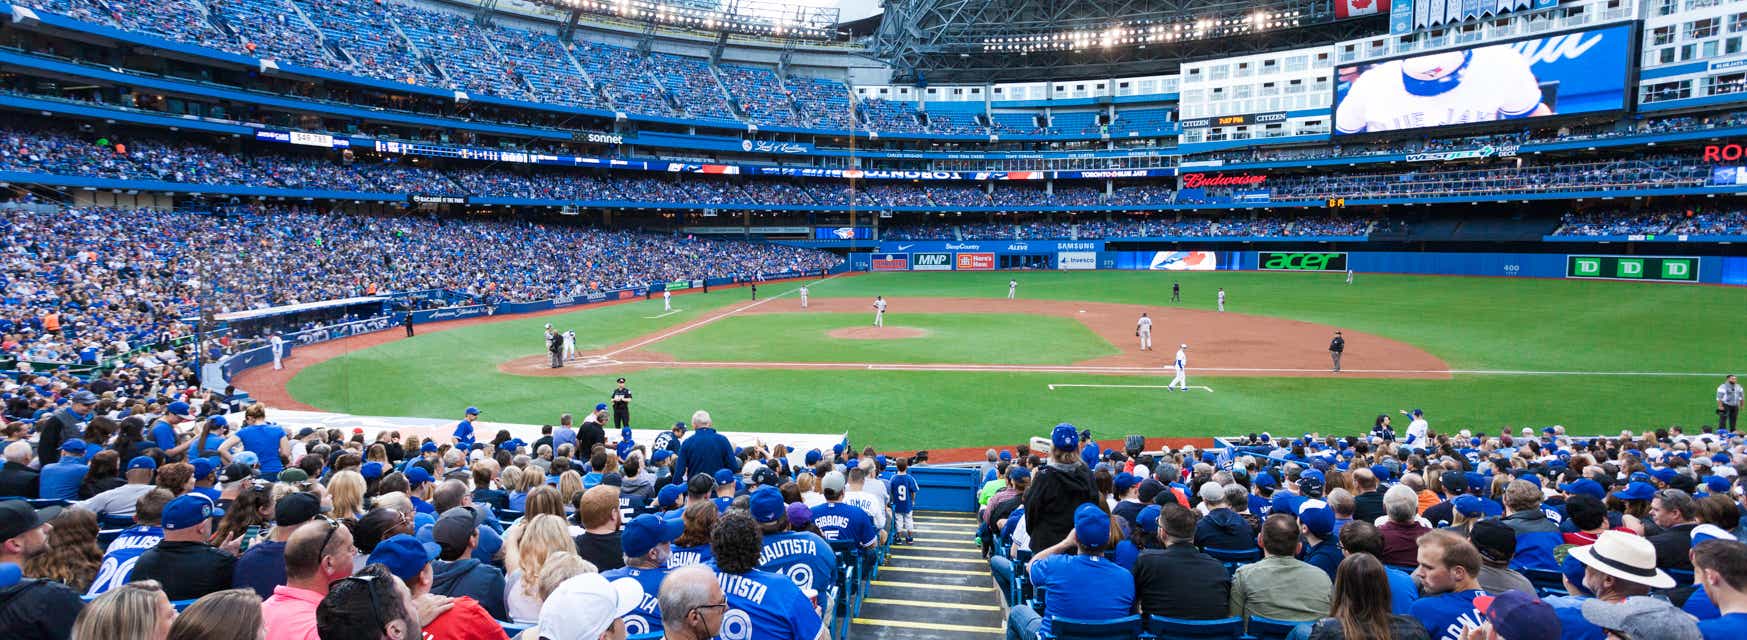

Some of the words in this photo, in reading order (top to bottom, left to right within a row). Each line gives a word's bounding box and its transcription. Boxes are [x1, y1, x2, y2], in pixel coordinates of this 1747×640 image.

[1182, 119, 1209, 128] CITIZEN
[1256, 112, 1286, 122] CITIZEN
[588, 133, 623, 144] sonnet
[1703, 144, 1747, 162] RO
[1081, 170, 1110, 178] TORONTO
[1183, 172, 1267, 188] Budweiser
[1057, 242, 1095, 250] SAMSUNG
[918, 254, 947, 265] MNP
[1265, 253, 1340, 270] acer
[1578, 260, 1598, 273] TD
[1620, 261, 1641, 274] TD
[1666, 262, 1688, 276] TD
[898, 485, 907, 501] 9
[815, 515, 849, 529] GIBBONS
